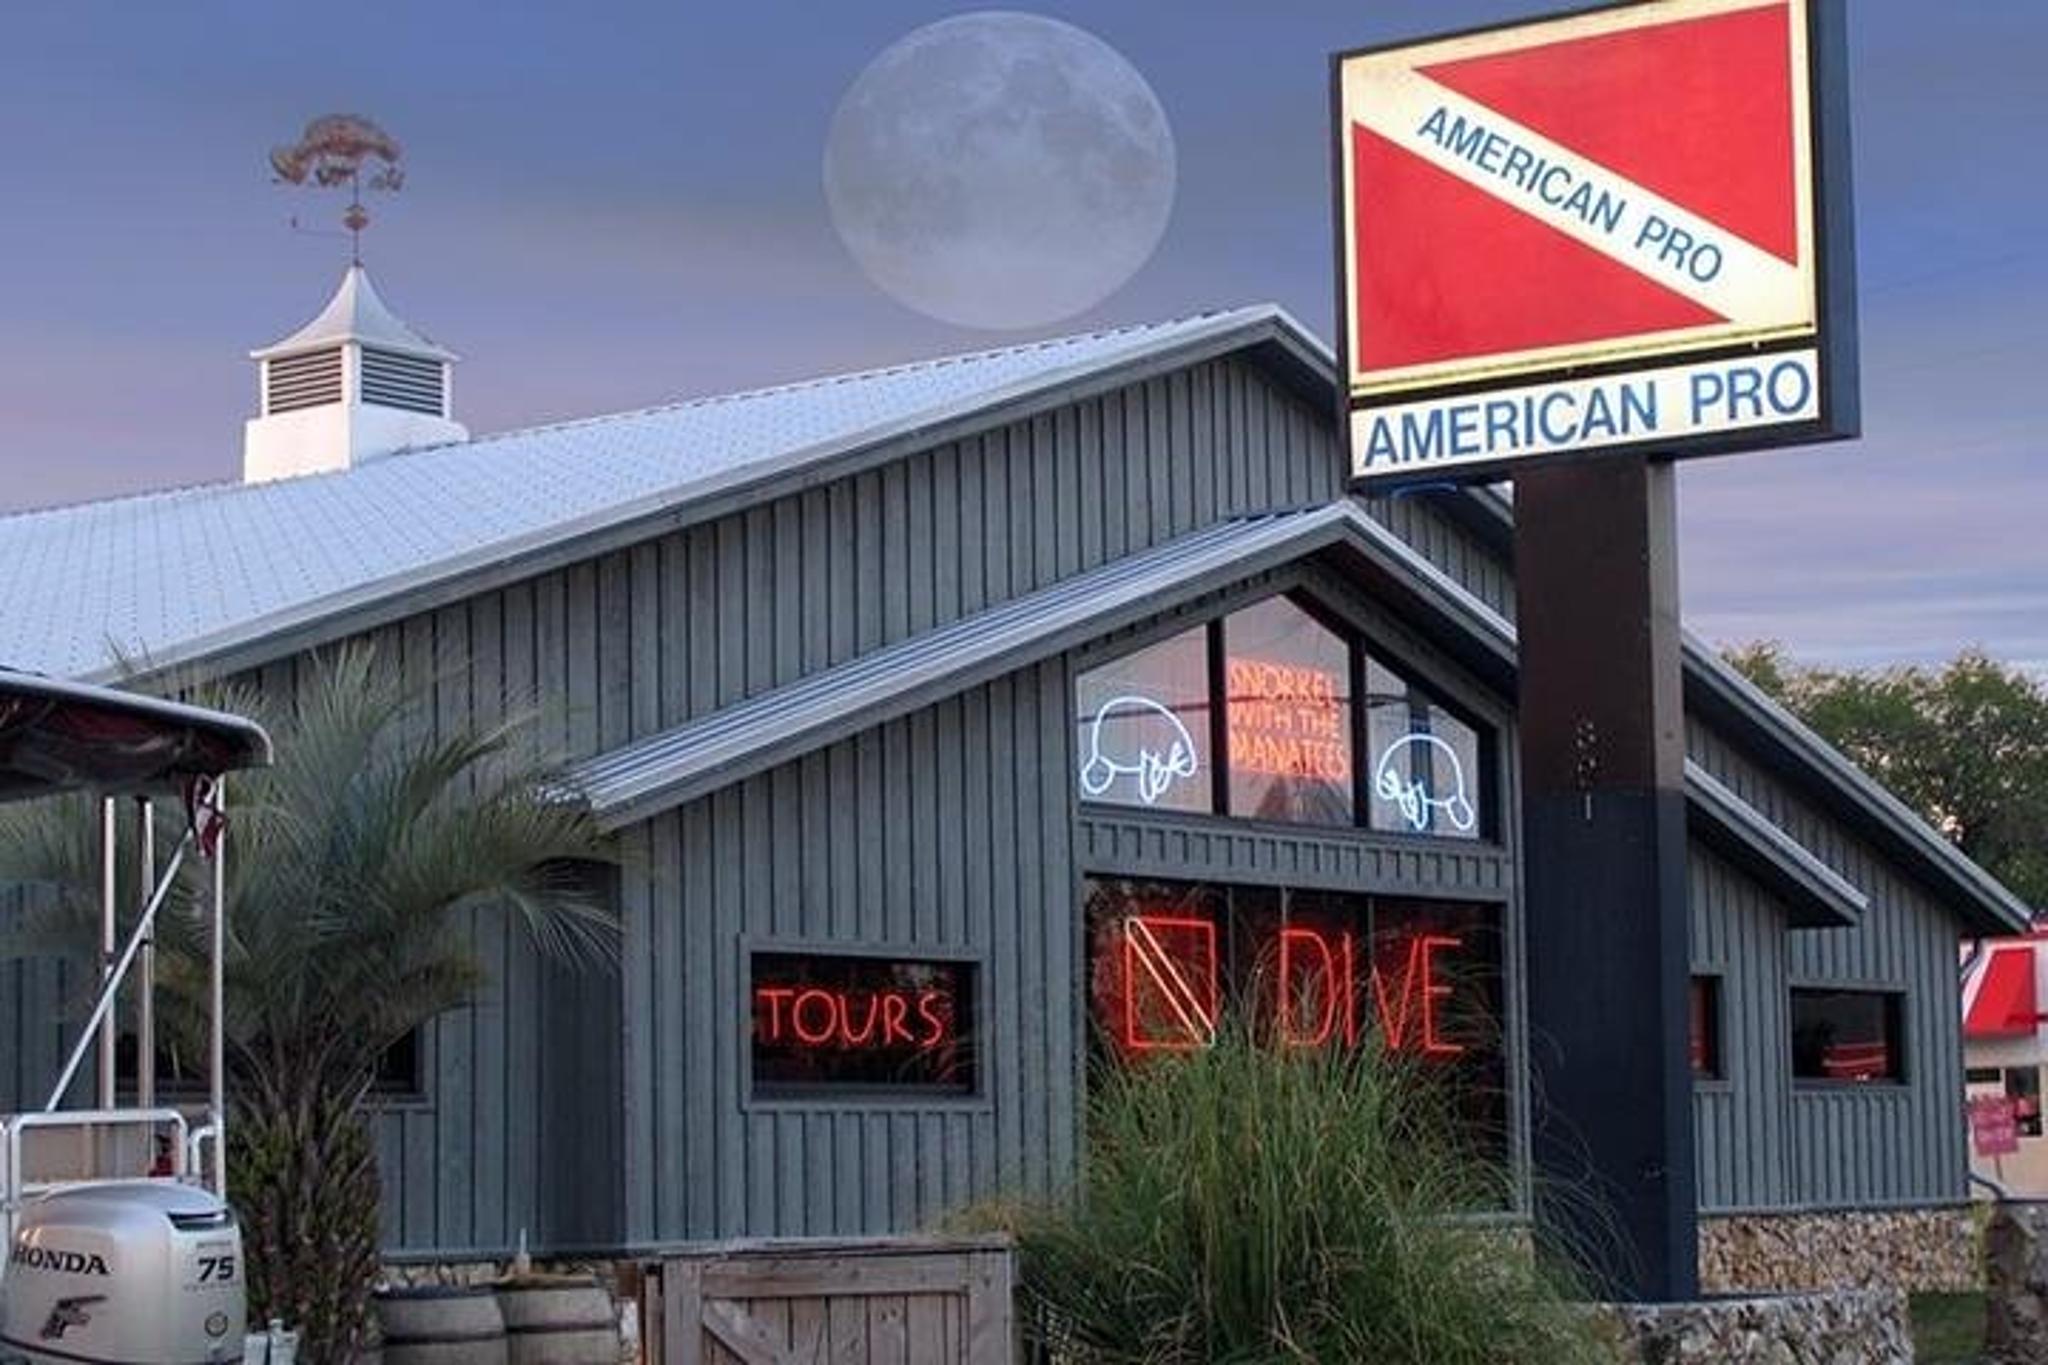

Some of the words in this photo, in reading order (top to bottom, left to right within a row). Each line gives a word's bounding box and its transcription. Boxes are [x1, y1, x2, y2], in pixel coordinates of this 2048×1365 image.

[1416, 106, 1626, 236] AMERICAN
[1634, 215, 1723, 283] PRO
[1364, 381, 1657, 468] AMERICAN
[1691, 360, 1811, 425] PRO
[1230, 660, 1334, 705] SNORKEL
[1229, 702, 1293, 730] WITH
[1297, 706, 1340, 738] THE
[1279, 928, 1464, 1052] DIVE
[757, 988, 943, 1048] TOURS
[11, 1244, 109, 1275] HONDA
[198, 1256, 234, 1282] 75
